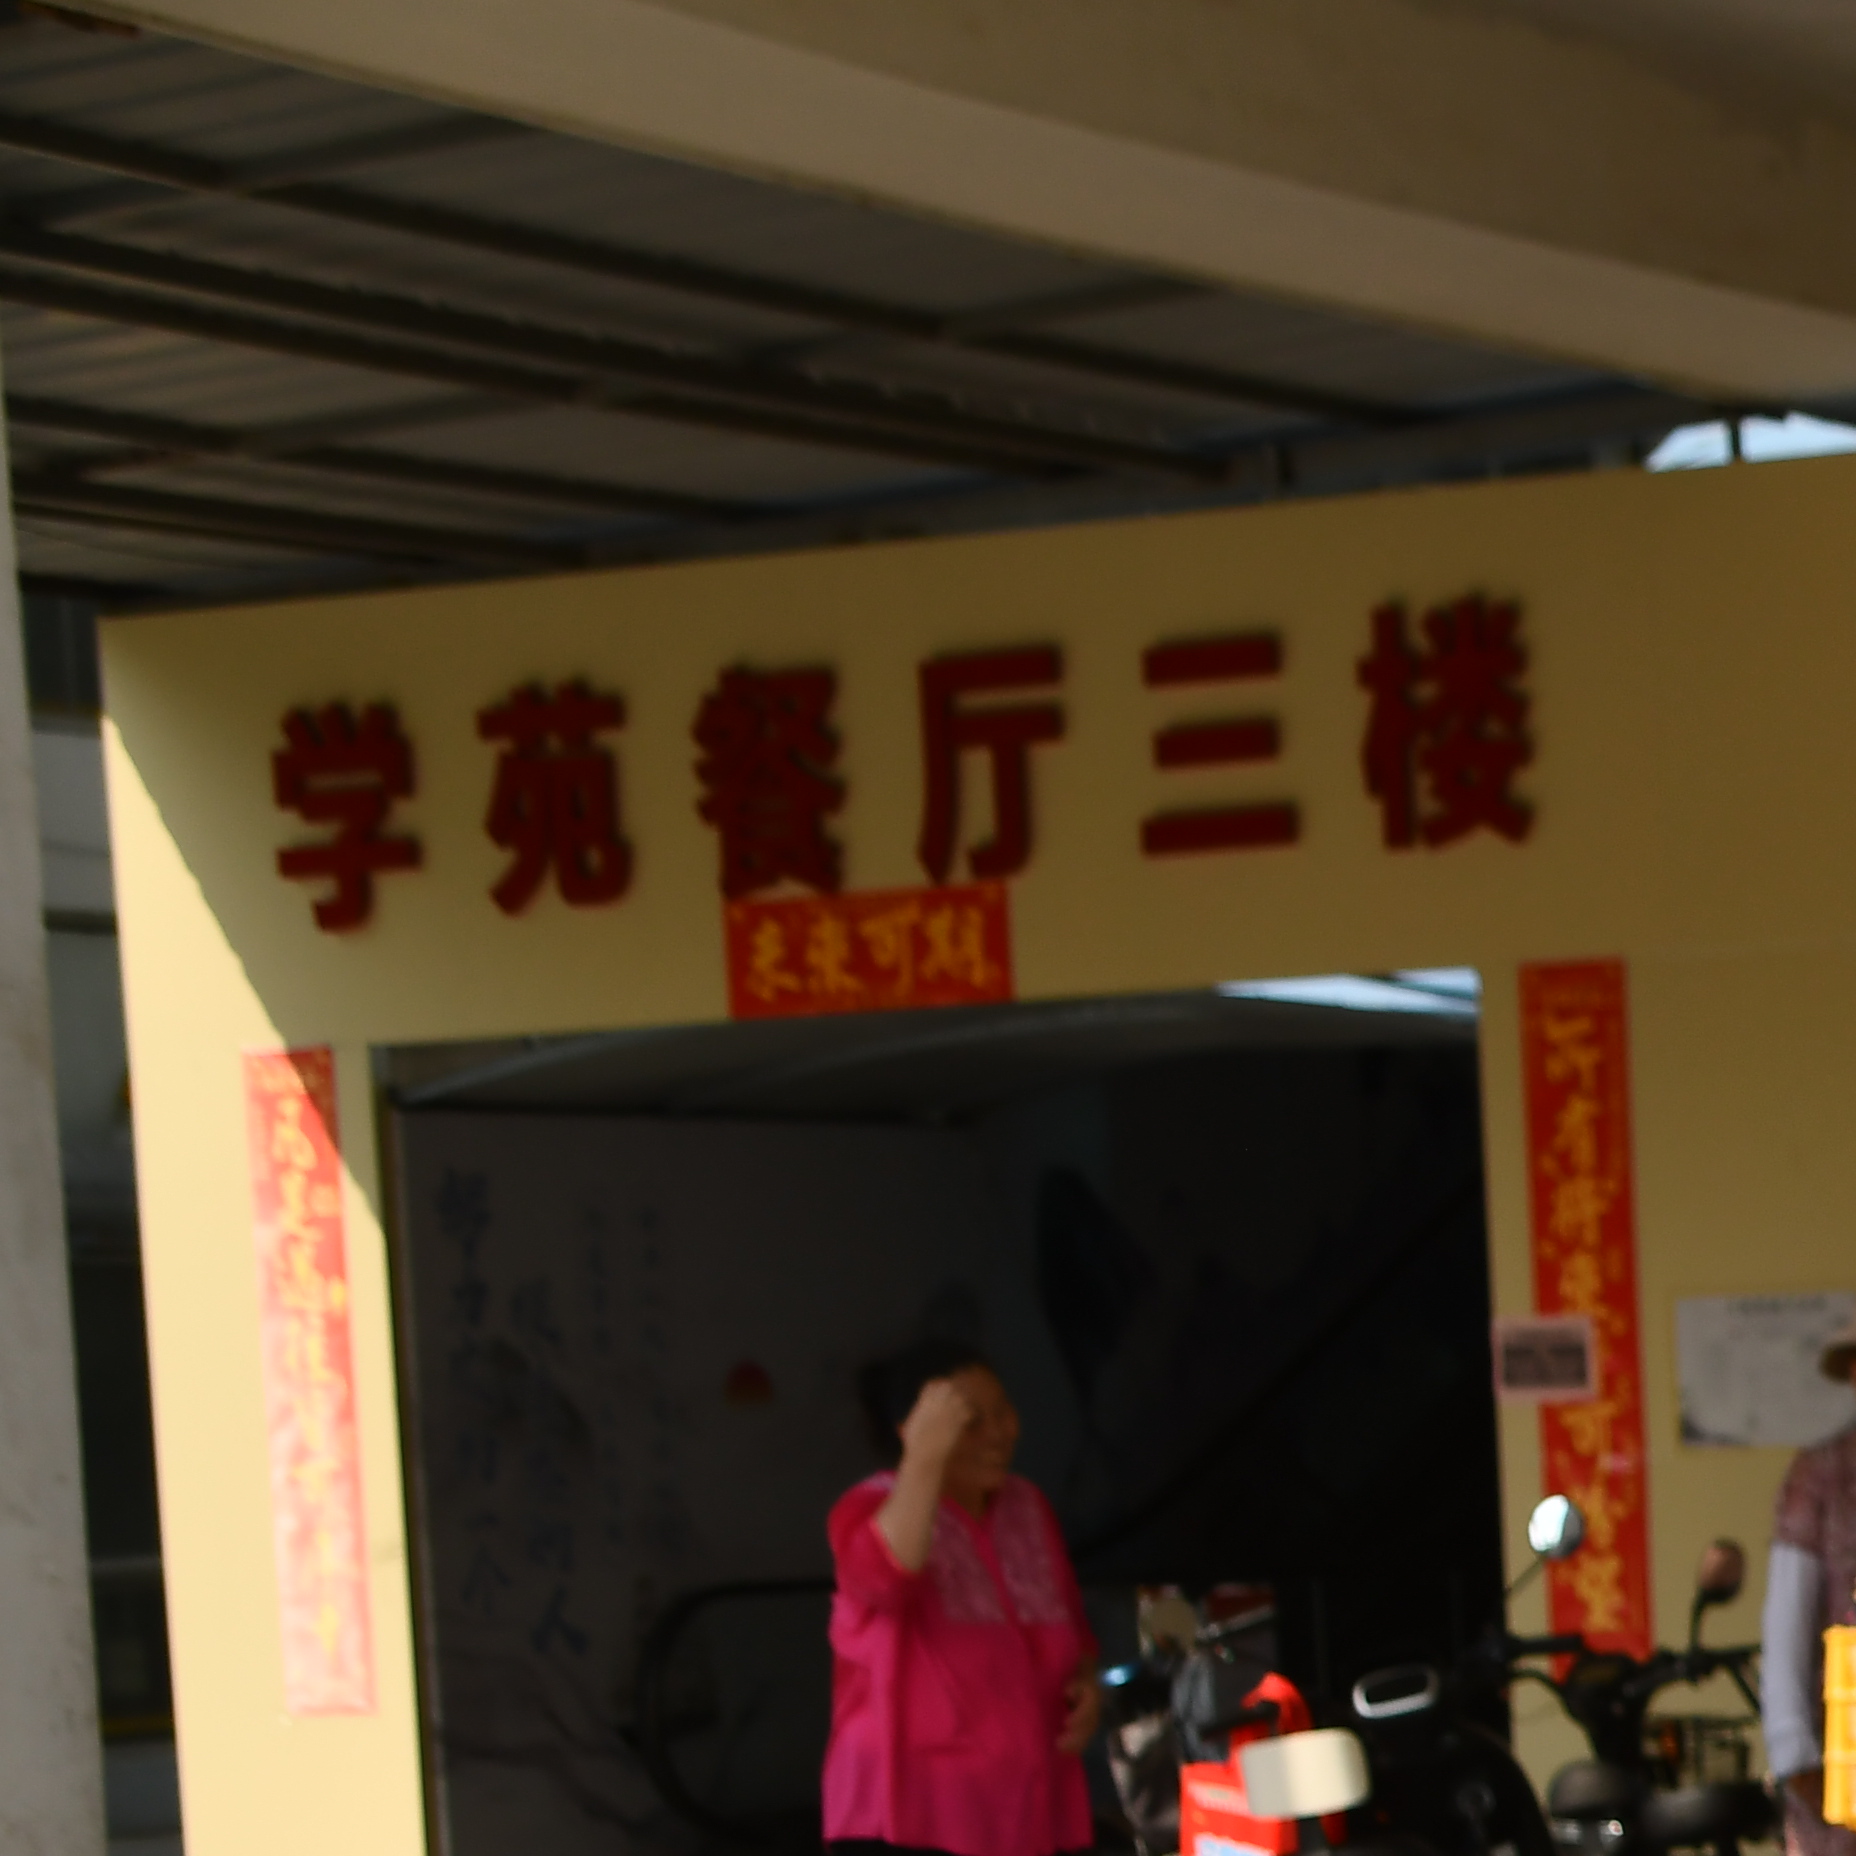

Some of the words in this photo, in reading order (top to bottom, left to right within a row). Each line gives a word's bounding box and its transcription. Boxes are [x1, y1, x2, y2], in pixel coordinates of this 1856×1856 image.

[270, 590, 1536, 934] 学苑餐厅三楼
